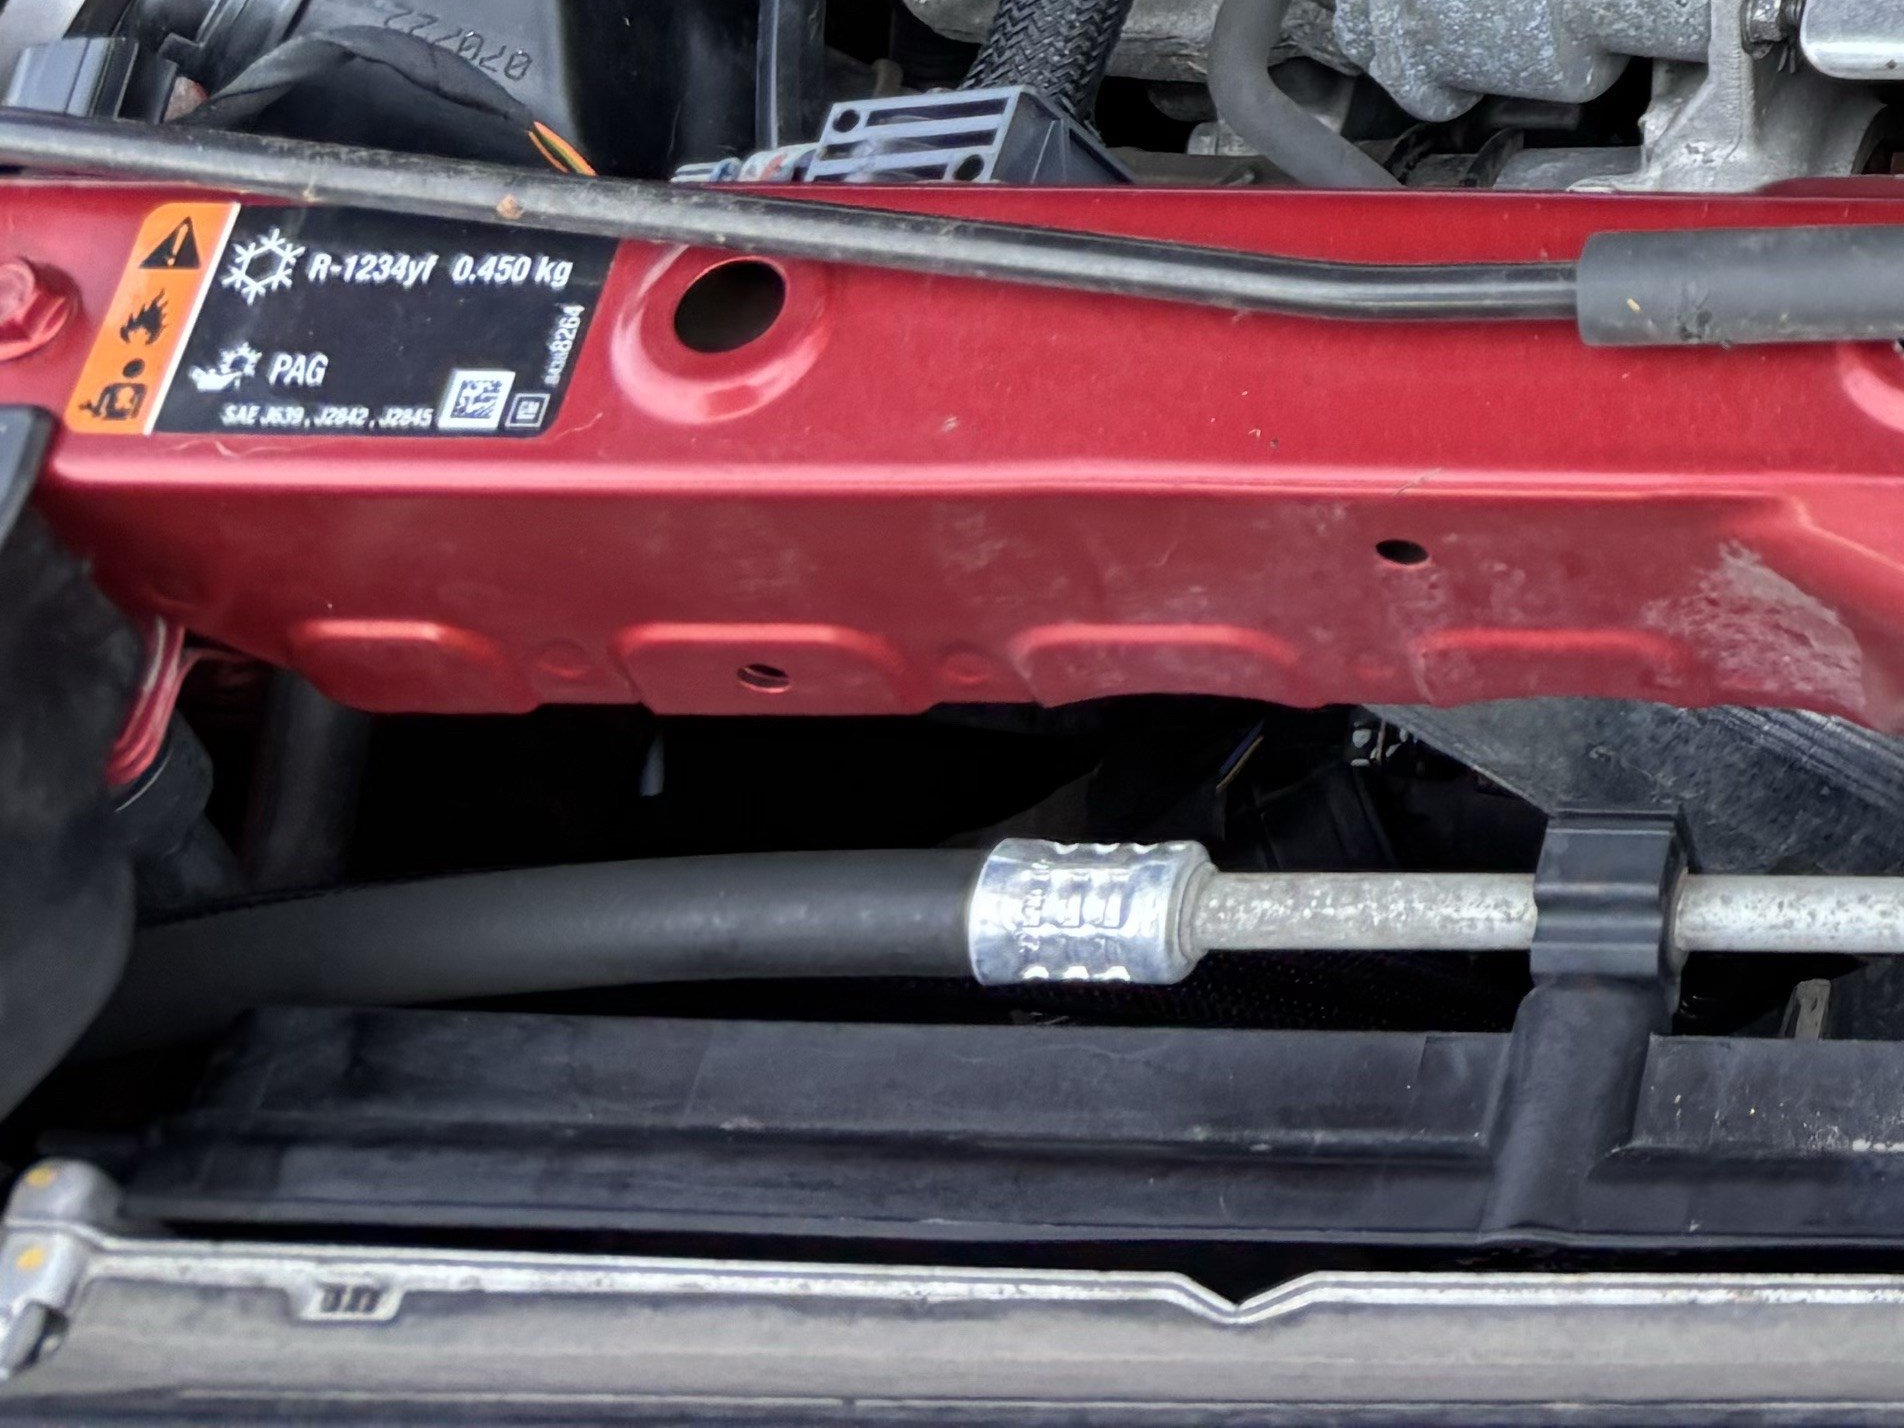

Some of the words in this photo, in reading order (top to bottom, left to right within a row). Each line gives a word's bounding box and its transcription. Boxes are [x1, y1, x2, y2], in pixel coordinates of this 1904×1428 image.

[308, 254, 438, 287] R-1234yf
[452, 257, 533, 283] 0.450
[535, 258, 573, 288] kg
[269, 353, 329, 385] PAG
[222, 403, 260, 426] SAE
[379, 407, 434, 429] J2845
